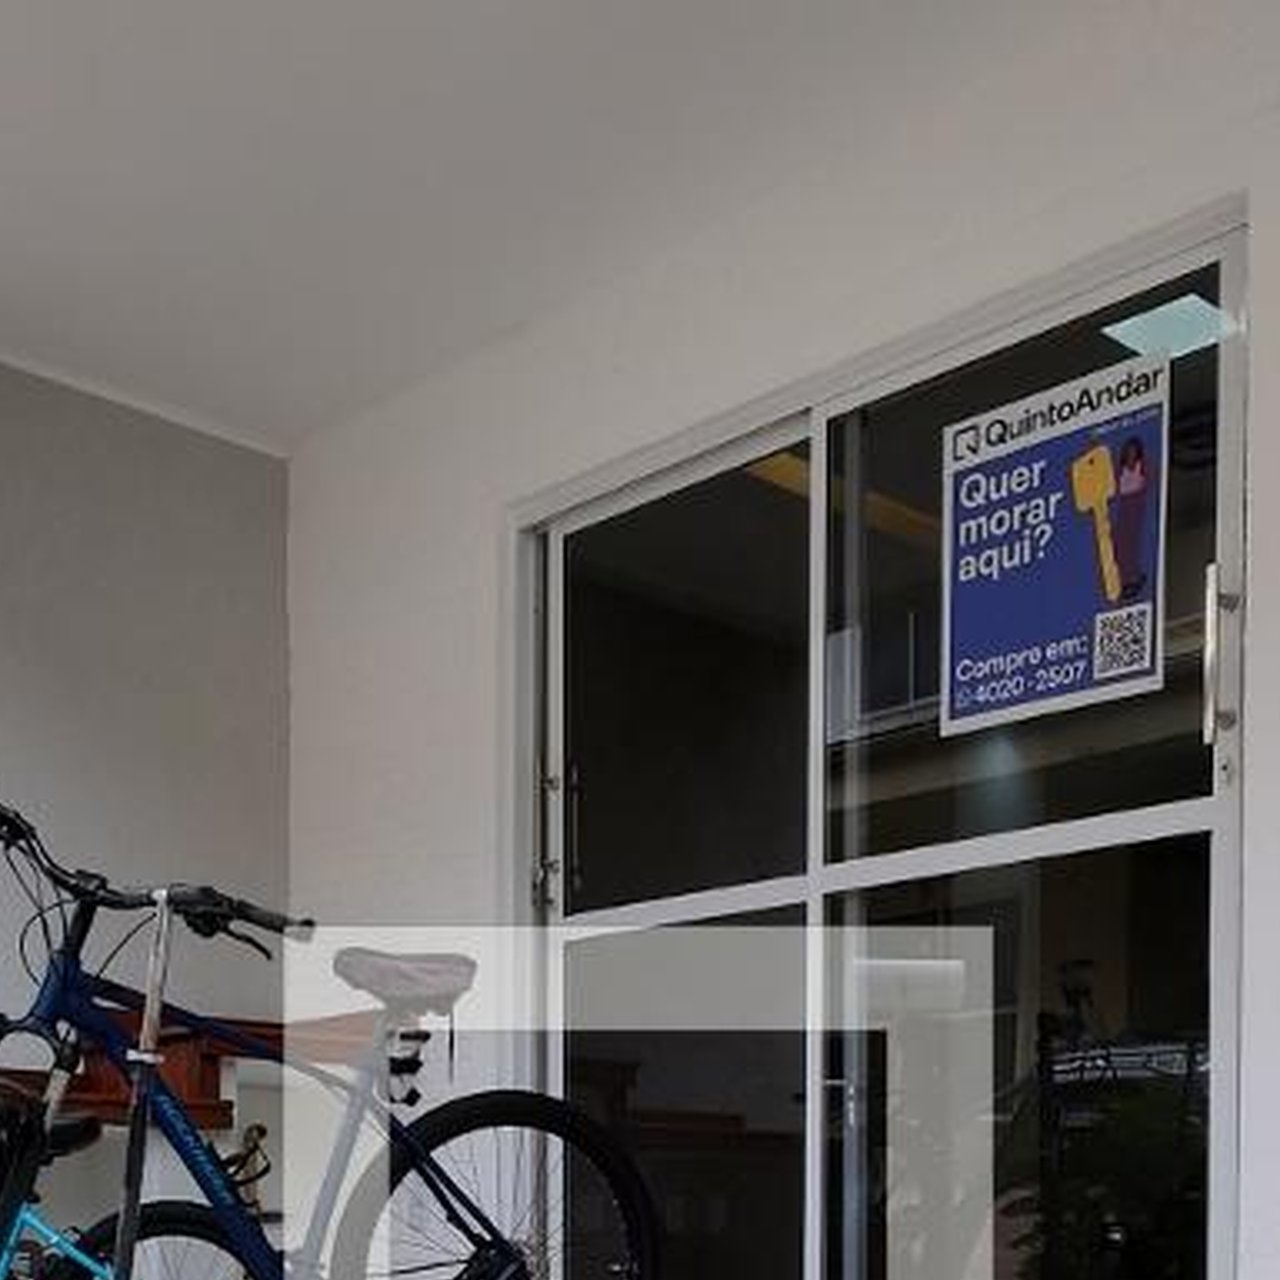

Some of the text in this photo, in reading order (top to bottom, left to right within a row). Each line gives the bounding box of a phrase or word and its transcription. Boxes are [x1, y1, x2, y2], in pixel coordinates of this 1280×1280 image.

[986, 368, 1162, 446] QuintoAndar
[960, 461, 1046, 508] Quer
[959, 492, 1064, 547] morar
[959, 524, 1053, 581] aqui?
